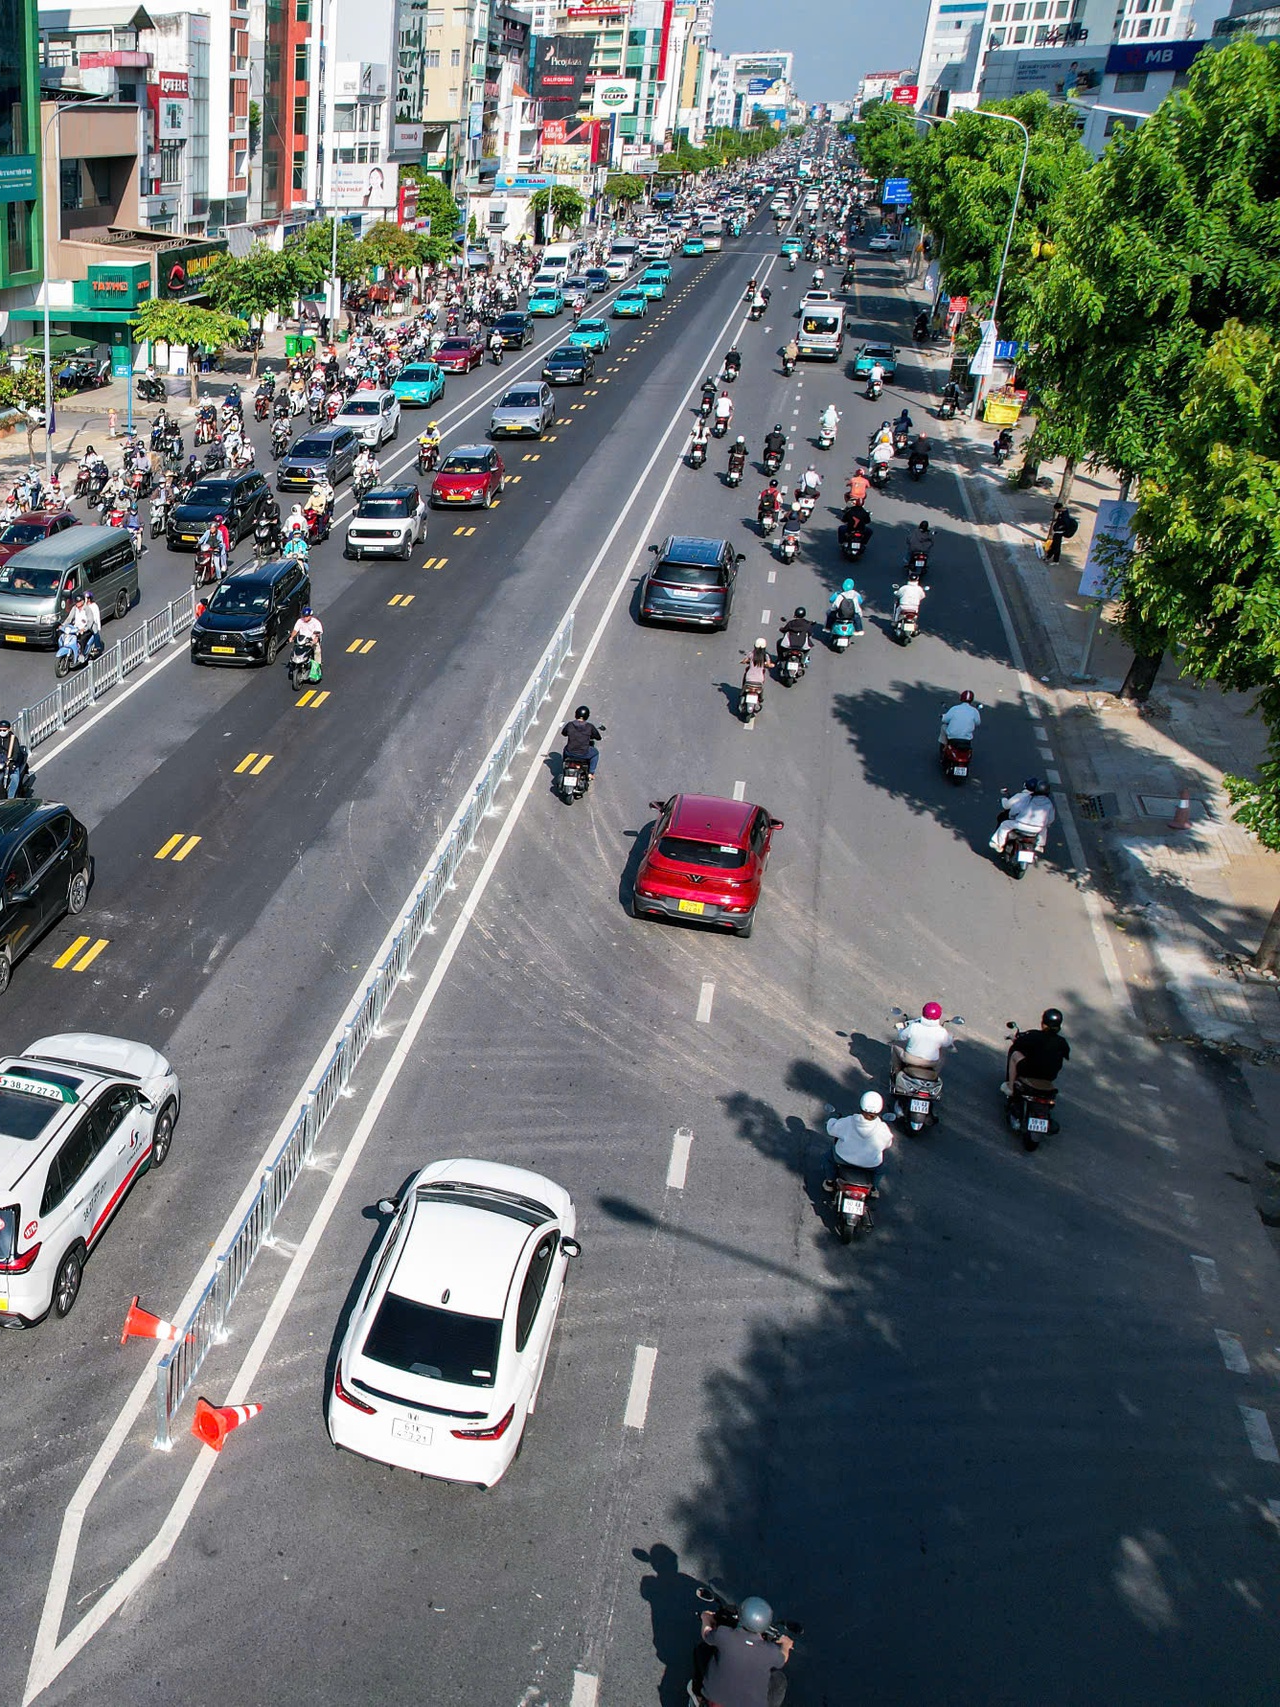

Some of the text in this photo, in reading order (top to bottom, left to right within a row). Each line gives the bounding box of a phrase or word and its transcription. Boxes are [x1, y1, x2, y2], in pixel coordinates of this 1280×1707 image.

[1145, 49, 1173, 63] MB
[9, 1080, 61, 1099] 38.27 27 27
